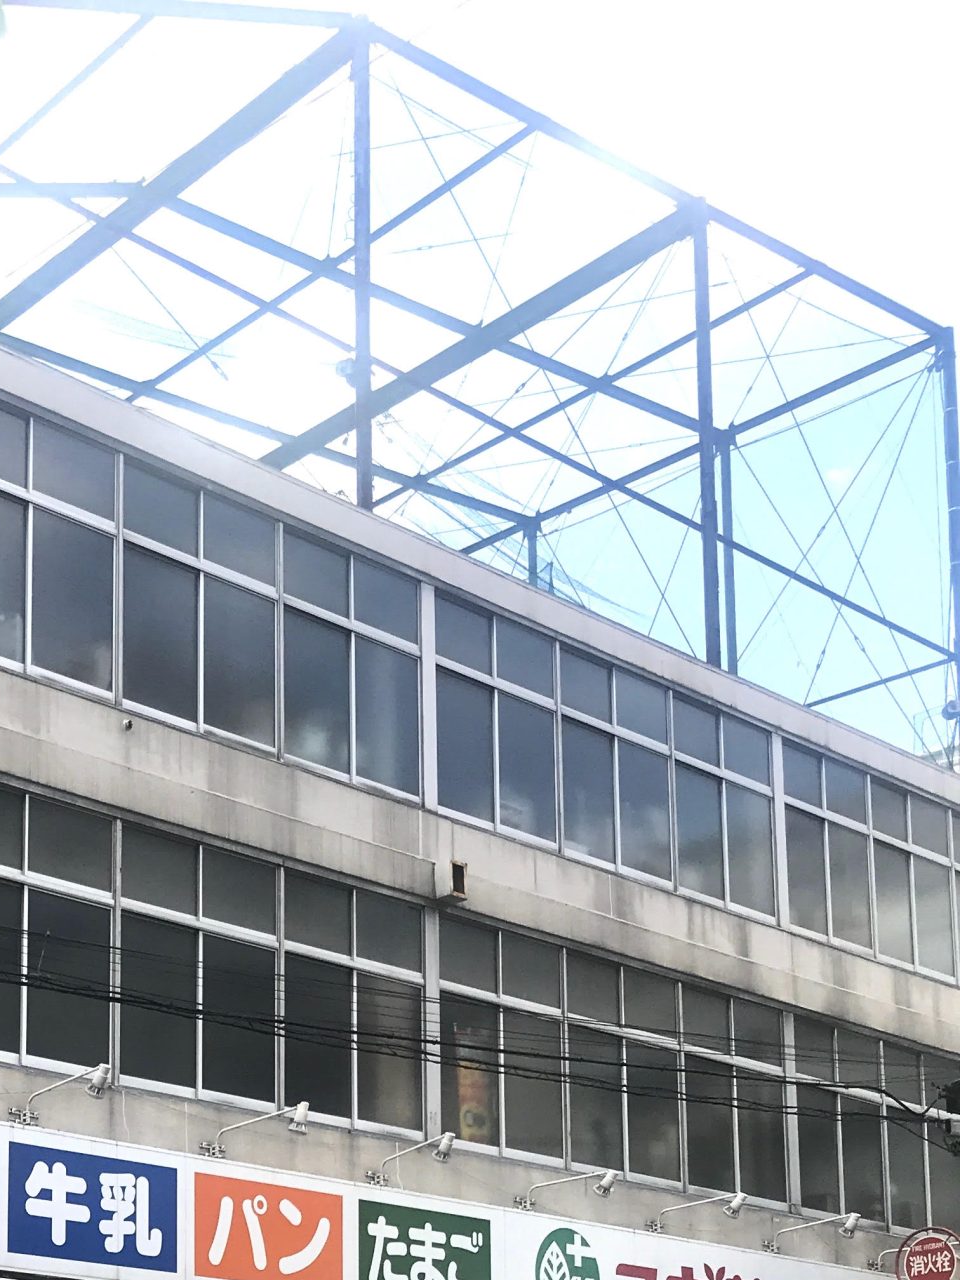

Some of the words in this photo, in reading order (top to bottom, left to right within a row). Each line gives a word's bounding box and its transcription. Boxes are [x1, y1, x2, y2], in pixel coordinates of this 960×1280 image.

[24, 1161, 164, 1258] 牛乳
[208, 1193, 331, 1276] パン
[909, 1250, 952, 1277] 消火栓
